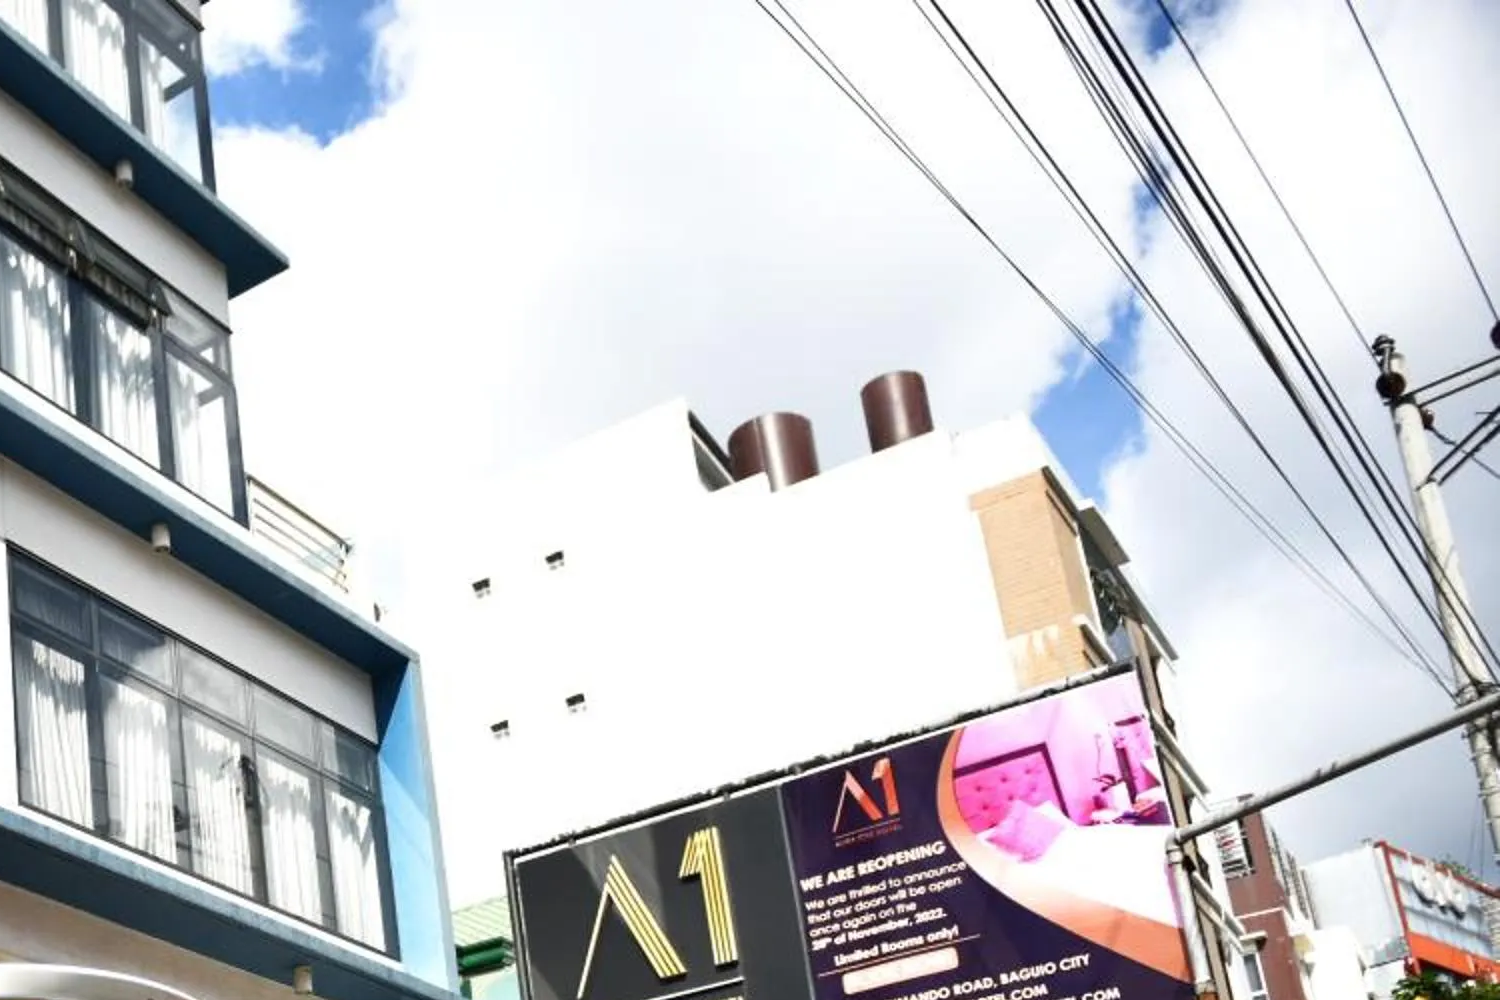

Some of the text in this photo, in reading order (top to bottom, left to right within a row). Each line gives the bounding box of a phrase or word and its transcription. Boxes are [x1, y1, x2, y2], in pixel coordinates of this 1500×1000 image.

[800, 840, 947, 892] WE ARE REOPENING
[804, 861, 967, 911] We are thrilled to announce
[807, 877, 963, 924] that our doors will be open
[809, 901, 917, 938] once again on the
[834, 945, 879, 966] Limited
[880, 935, 924, 955] Rooms
[952, 977, 998, 996] ROAD,
[999, 961, 1057, 985] BAGUIO
[1059, 953, 1091, 971] CITY
